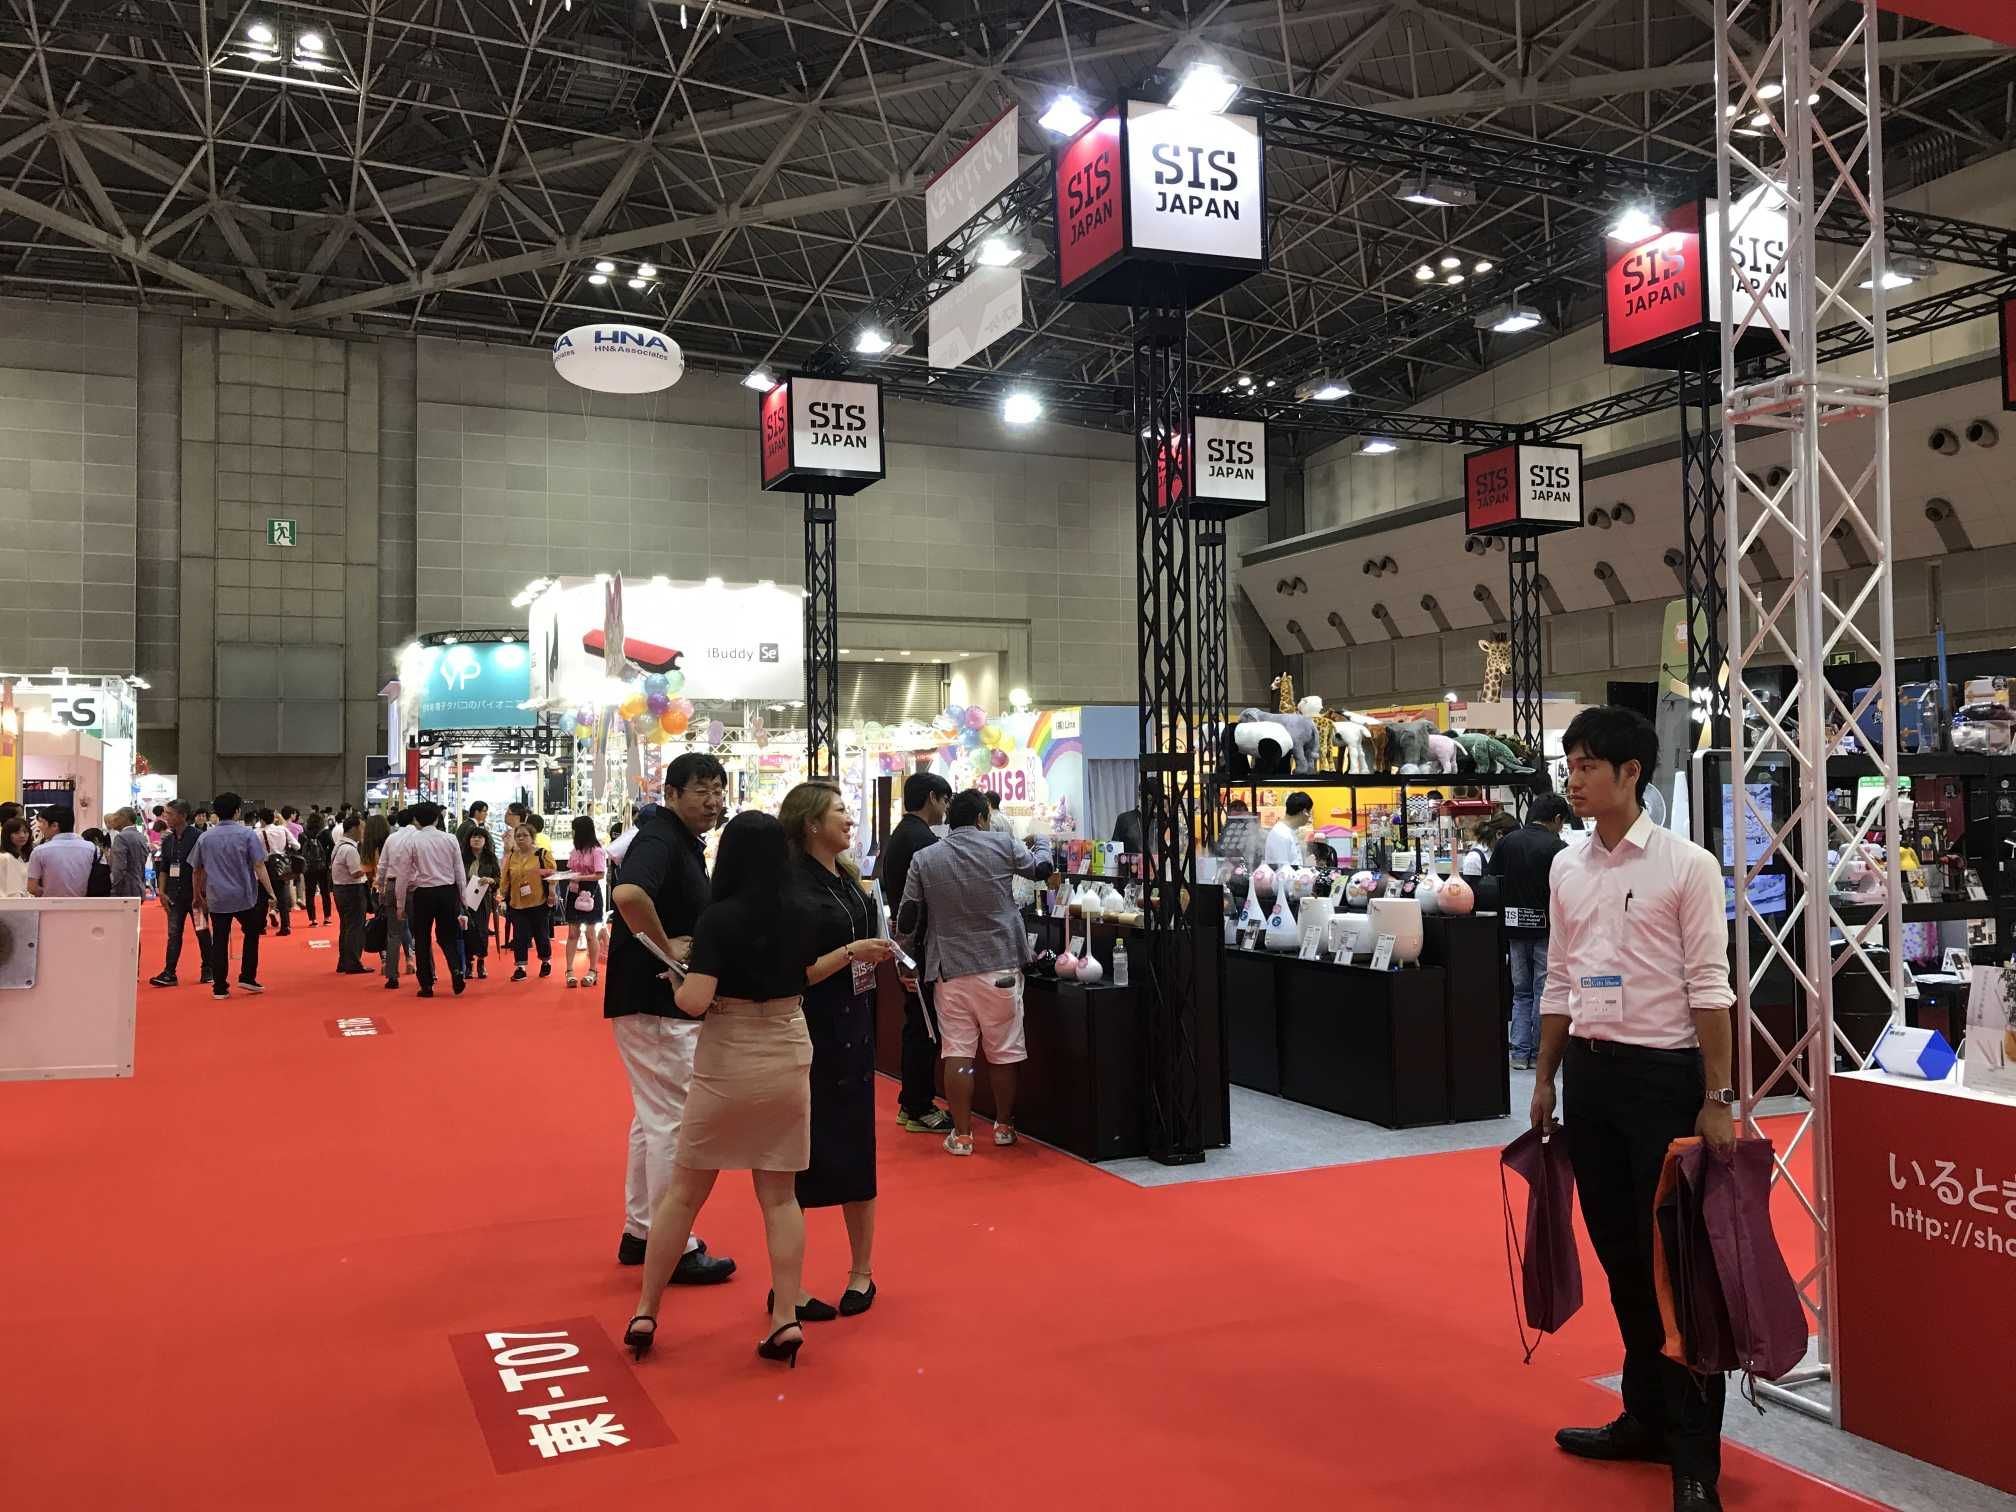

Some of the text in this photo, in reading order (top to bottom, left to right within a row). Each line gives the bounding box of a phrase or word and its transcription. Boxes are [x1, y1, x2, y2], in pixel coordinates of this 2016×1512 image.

[1152, 143, 1238, 191] SIS
[1067, 151, 1112, 220] SIS
[1155, 192, 1240, 220] JAPAN
[1070, 199, 1112, 246] JAPAN
[1622, 247, 1685, 296] SIS
[1625, 282, 1686, 317] JAPAN
[594, 330, 668, 353] HNA
[767, 406, 785, 442] SIS
[808, 402, 866, 431] SIS
[768, 437, 785, 457] JAPAN
[811, 433, 867, 448] JAPAN
[1207, 438, 1254, 465] SIS
[1208, 466, 1254, 480] JAPAN
[1476, 467, 1508, 496] SIS
[1530, 465, 1570, 488] SIS
[1476, 488, 1509, 509] JAPAN
[1531, 490, 1571, 503] JAPAN
[760, 644, 777, 661] Se
[484, 1331, 631, 1458] 東1-T07
